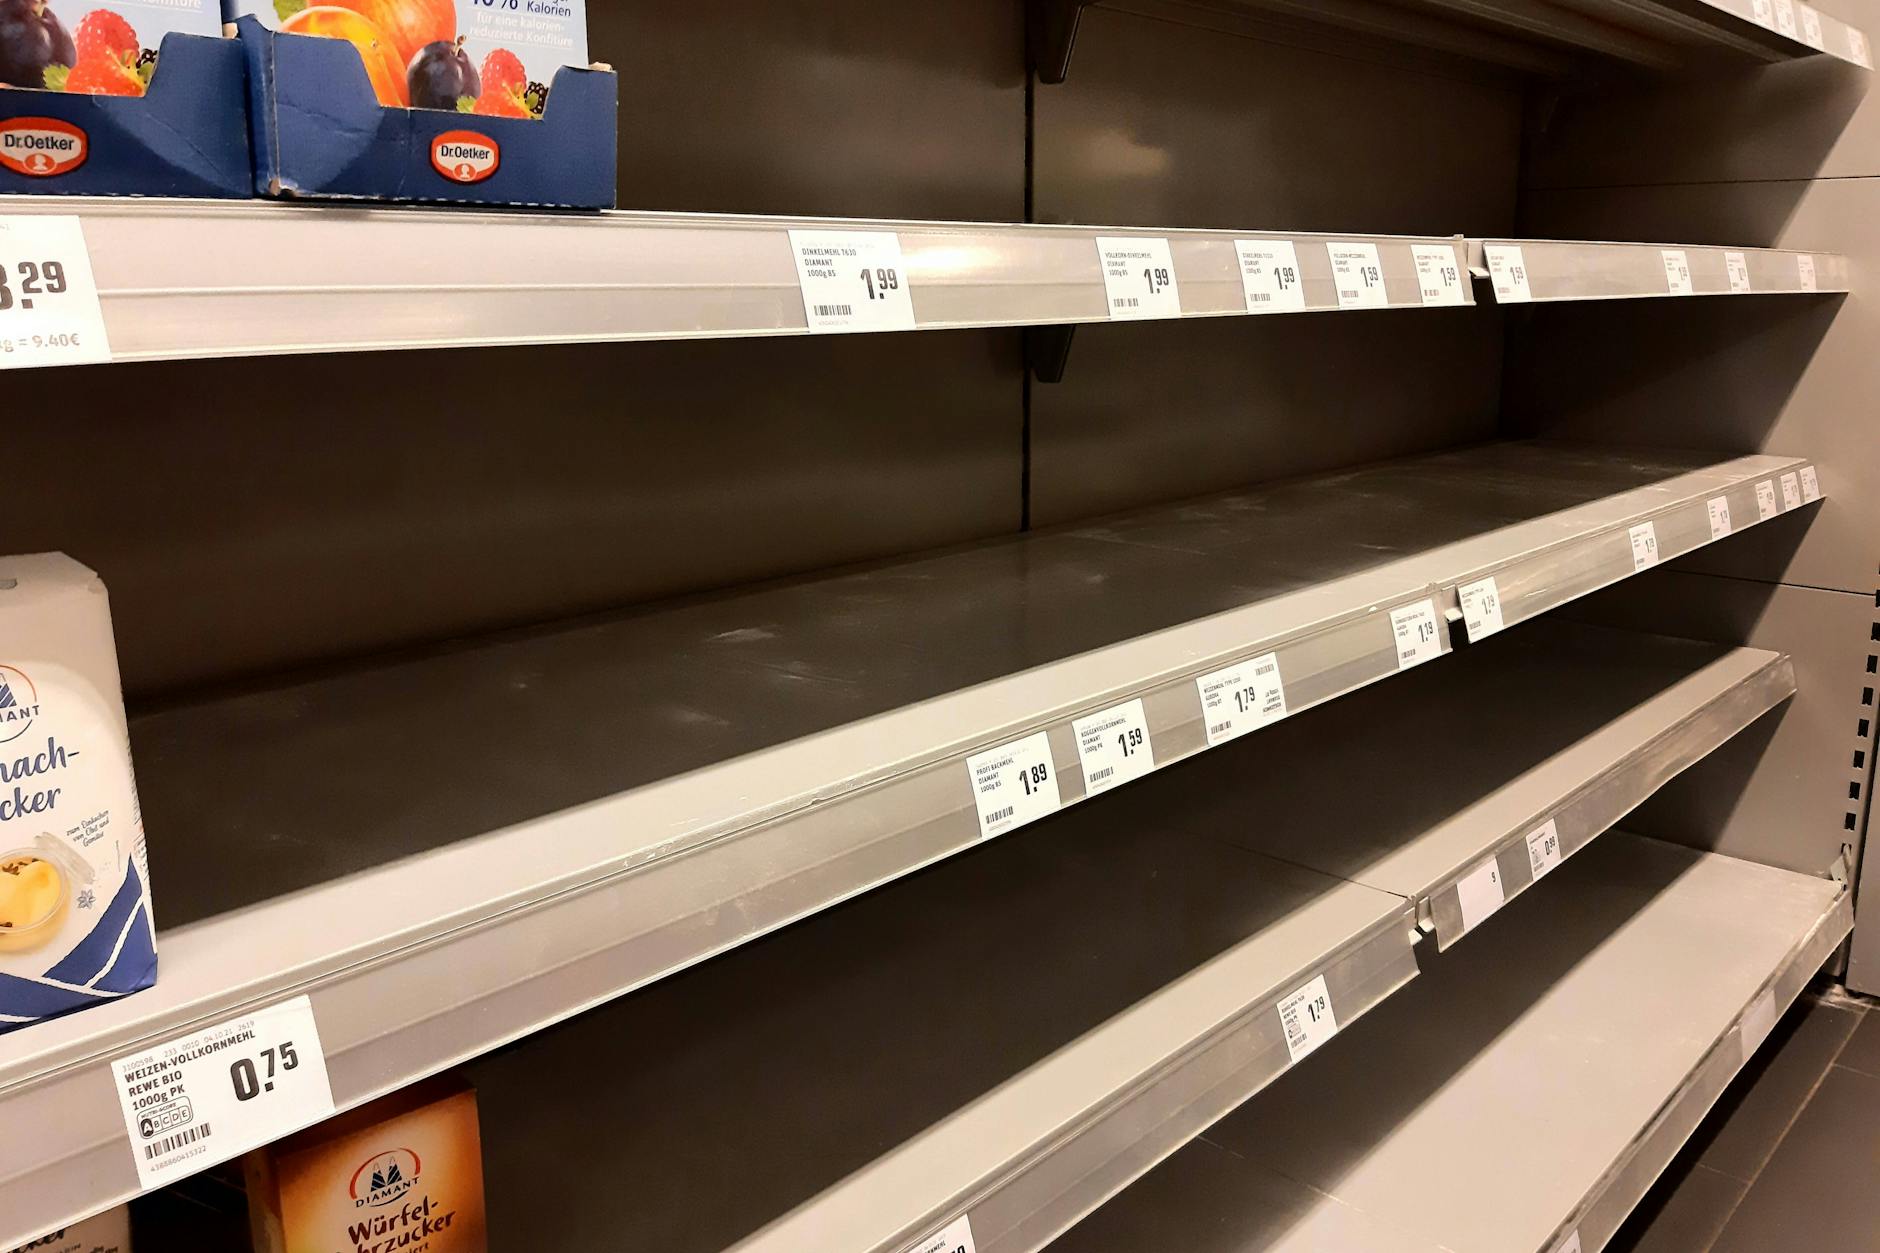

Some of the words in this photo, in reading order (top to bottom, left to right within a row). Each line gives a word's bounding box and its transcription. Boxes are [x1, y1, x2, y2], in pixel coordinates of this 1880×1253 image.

[527, 1, 571, 17] Kalorien
[495, 14, 519, 28] eine
[470, 26, 524, 41] reduzierte
[802, 248, 841, 256] DINKELMEHL
[804, 258, 833, 267] DIAMANT
[807, 269, 828, 279] 1000g
[861, 268, 898, 300] 1.99
[1144, 268, 1169, 294] 1.99
[1274, 267, 1295, 290] 1.99
[1360, 266, 1379, 288] 1.59
[32, 333, 81, 347] 9.40€
[1235, 686, 1255, 713] 1.79
[1083, 735, 1101, 746] DIAMANT
[1118, 728, 1143, 758] 1.59
[991, 757, 1014, 770] BACKMEHL
[978, 772, 999, 784] DIAMANT
[980, 783, 995, 793] 1000g
[1019, 763, 1048, 796] 1.89
[1307, 996, 1325, 1023] 1.79
[203, 1028, 233, 1043] 04.10.21
[124, 1030, 256, 1083] WEIZEN-VOLLKORNMEHL
[230, 1041, 299, 1102] 0.75
[128, 1078, 160, 1097] REWE
[162, 1070, 182, 1085] BIO
[132, 1091, 168, 1111] 1000g
[170, 1084, 185, 1097] PK
[355, 1176, 420, 1208] DIAMANT
[348, 1195, 439, 1245] Würfel-
